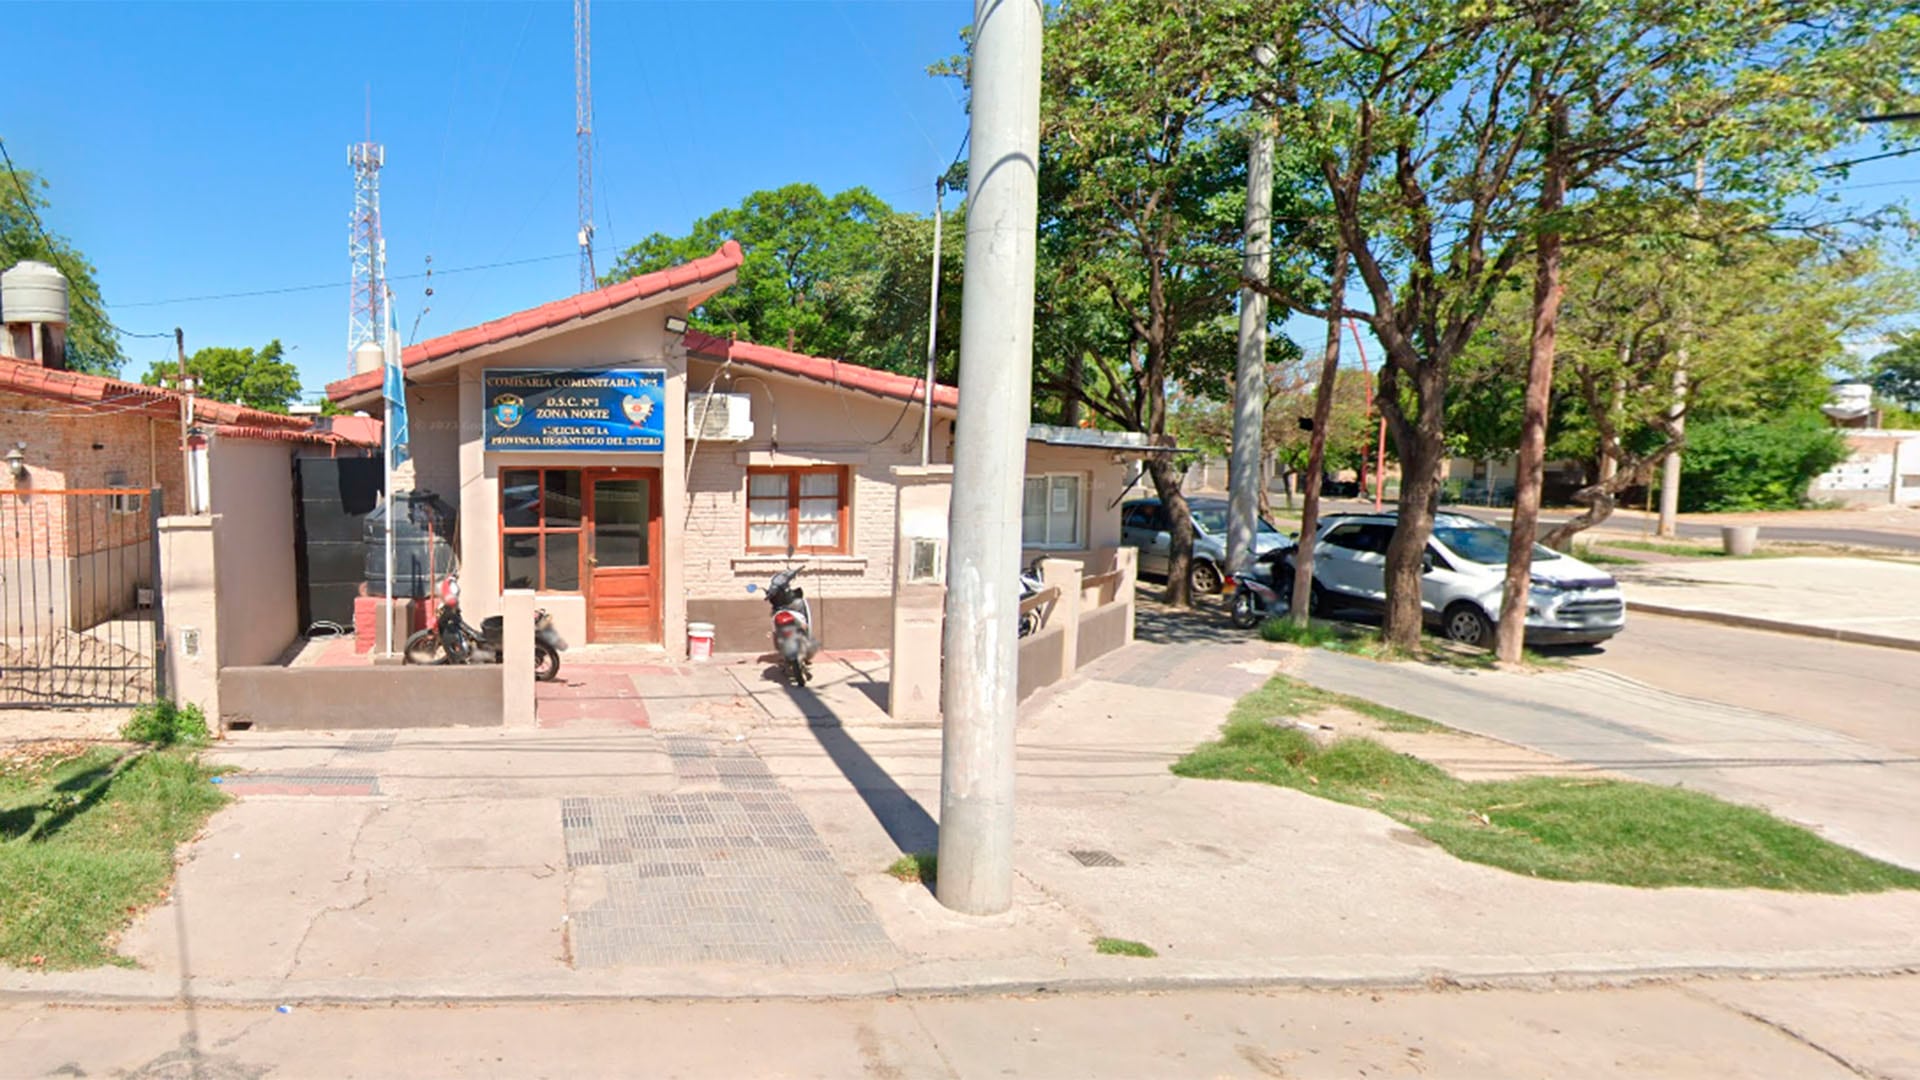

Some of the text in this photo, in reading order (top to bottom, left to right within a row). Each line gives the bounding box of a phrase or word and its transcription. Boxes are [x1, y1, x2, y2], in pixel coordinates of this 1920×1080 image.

[486, 377, 552, 388] COMISARIA
[554, 378, 637, 387] COMUNITARIA
[546, 397, 578, 407] D.S.C.
[536, 408, 609, 419] ZONA NORTE
[582, 427, 595, 435] DE
[597, 427, 609, 435] LA
[491, 436, 542, 446] PROVINCIA
[606, 436, 625, 446] DEL
[626, 436, 661, 446] ESTERO
